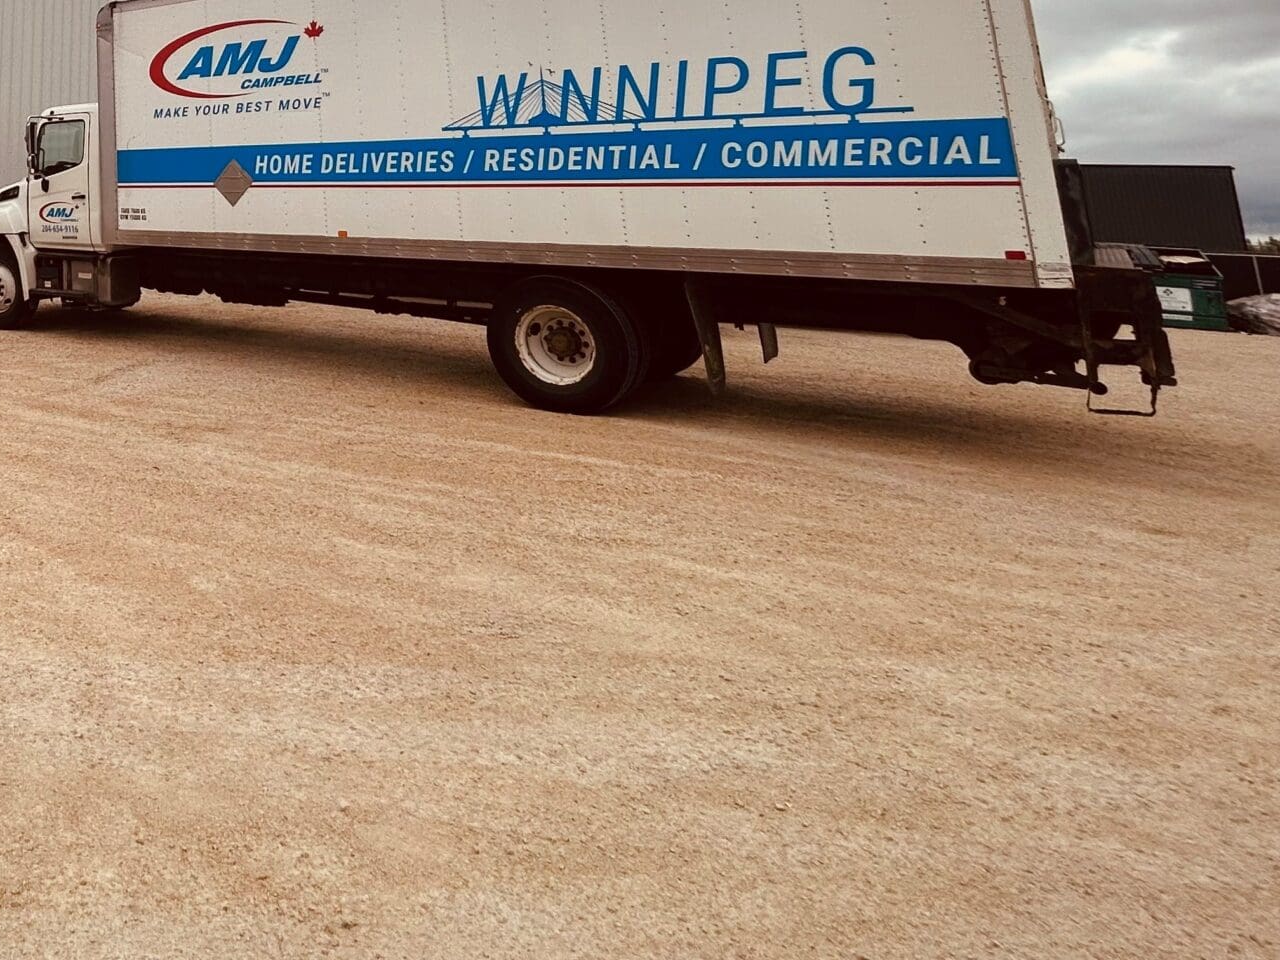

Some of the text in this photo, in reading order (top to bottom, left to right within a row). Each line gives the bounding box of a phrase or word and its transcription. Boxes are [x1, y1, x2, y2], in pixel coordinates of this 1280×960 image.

[176, 35, 301, 81] AMJ
[240, 73, 323, 90] CAMPBELL
[477, 46, 876, 128] WINNIPEG
[153, 107, 189, 119] MAKE
[195, 104, 230, 116] YOUR
[236, 101, 273, 114] BEST
[278, 97, 322, 111] MOVE
[255, 154, 313, 175] HOME
[320, 150, 455, 174] DELIVERIES
[483, 144, 680, 172] RESIDENTIAL
[721, 135, 1002, 168] COMMERCIAL
[46, 208, 75, 218] AMJ
